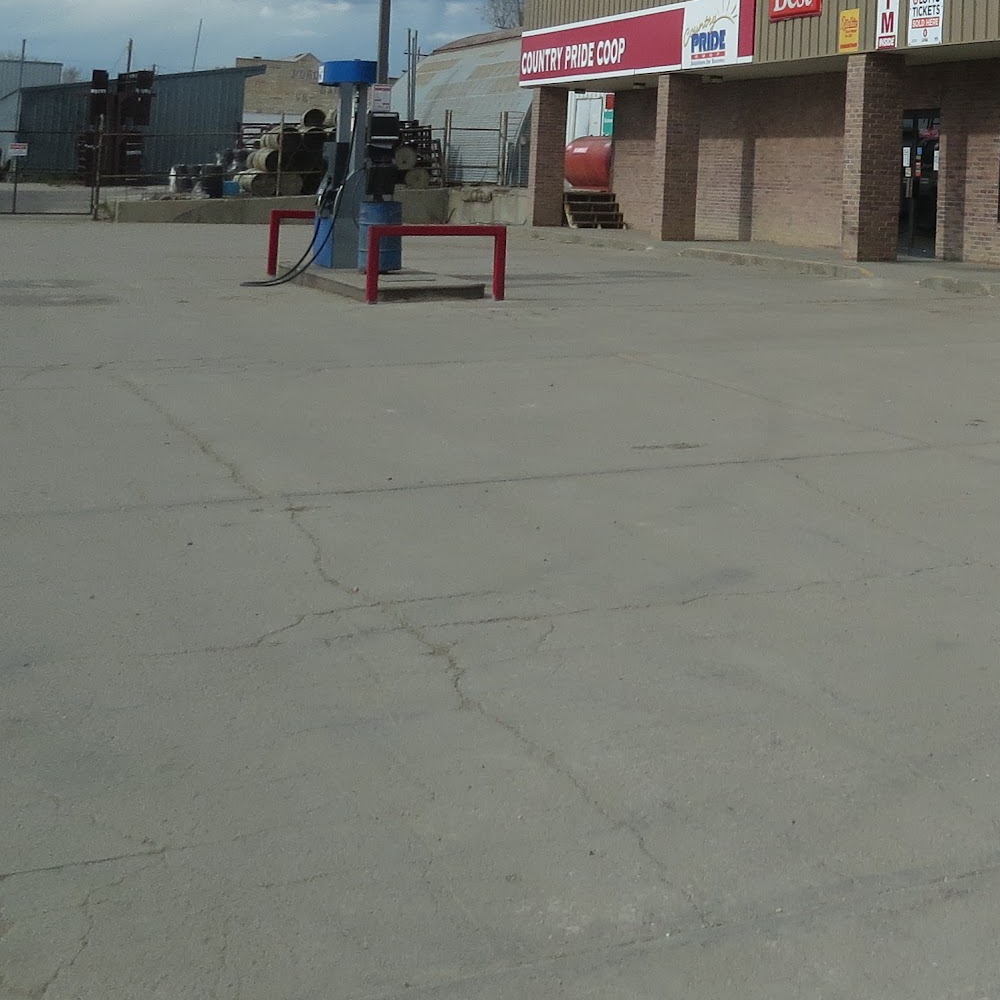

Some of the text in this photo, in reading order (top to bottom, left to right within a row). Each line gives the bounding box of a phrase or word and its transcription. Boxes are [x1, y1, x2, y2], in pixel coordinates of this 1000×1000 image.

[912, 4, 941, 17] TICKETS
[912, 17, 939, 28] SOLD HERE
[691, 29, 726, 53] PRIDE
[521, 37, 626, 75] COUNTRY PRIDE COOP
